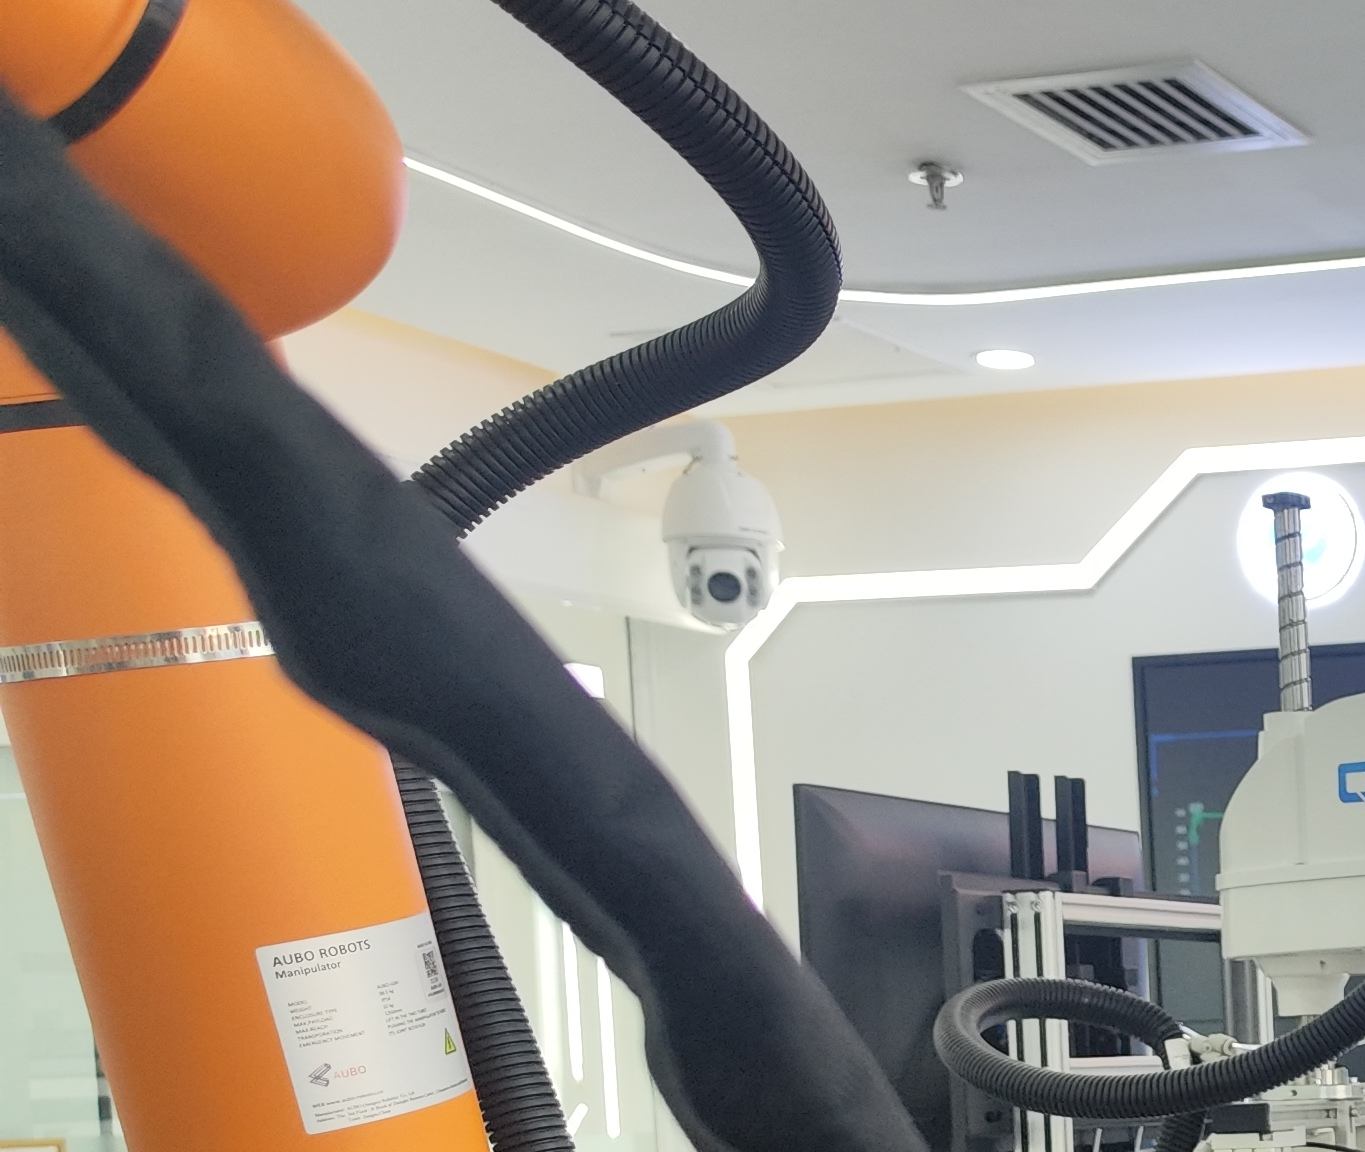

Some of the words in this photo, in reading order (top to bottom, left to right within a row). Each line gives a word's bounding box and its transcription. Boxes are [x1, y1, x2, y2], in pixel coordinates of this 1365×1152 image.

[272, 950, 315, 968] AUBO
[319, 939, 371, 958] ROBOTS
[275, 961, 341, 980] Manipulator
[333, 1065, 367, 1080] AUBO
